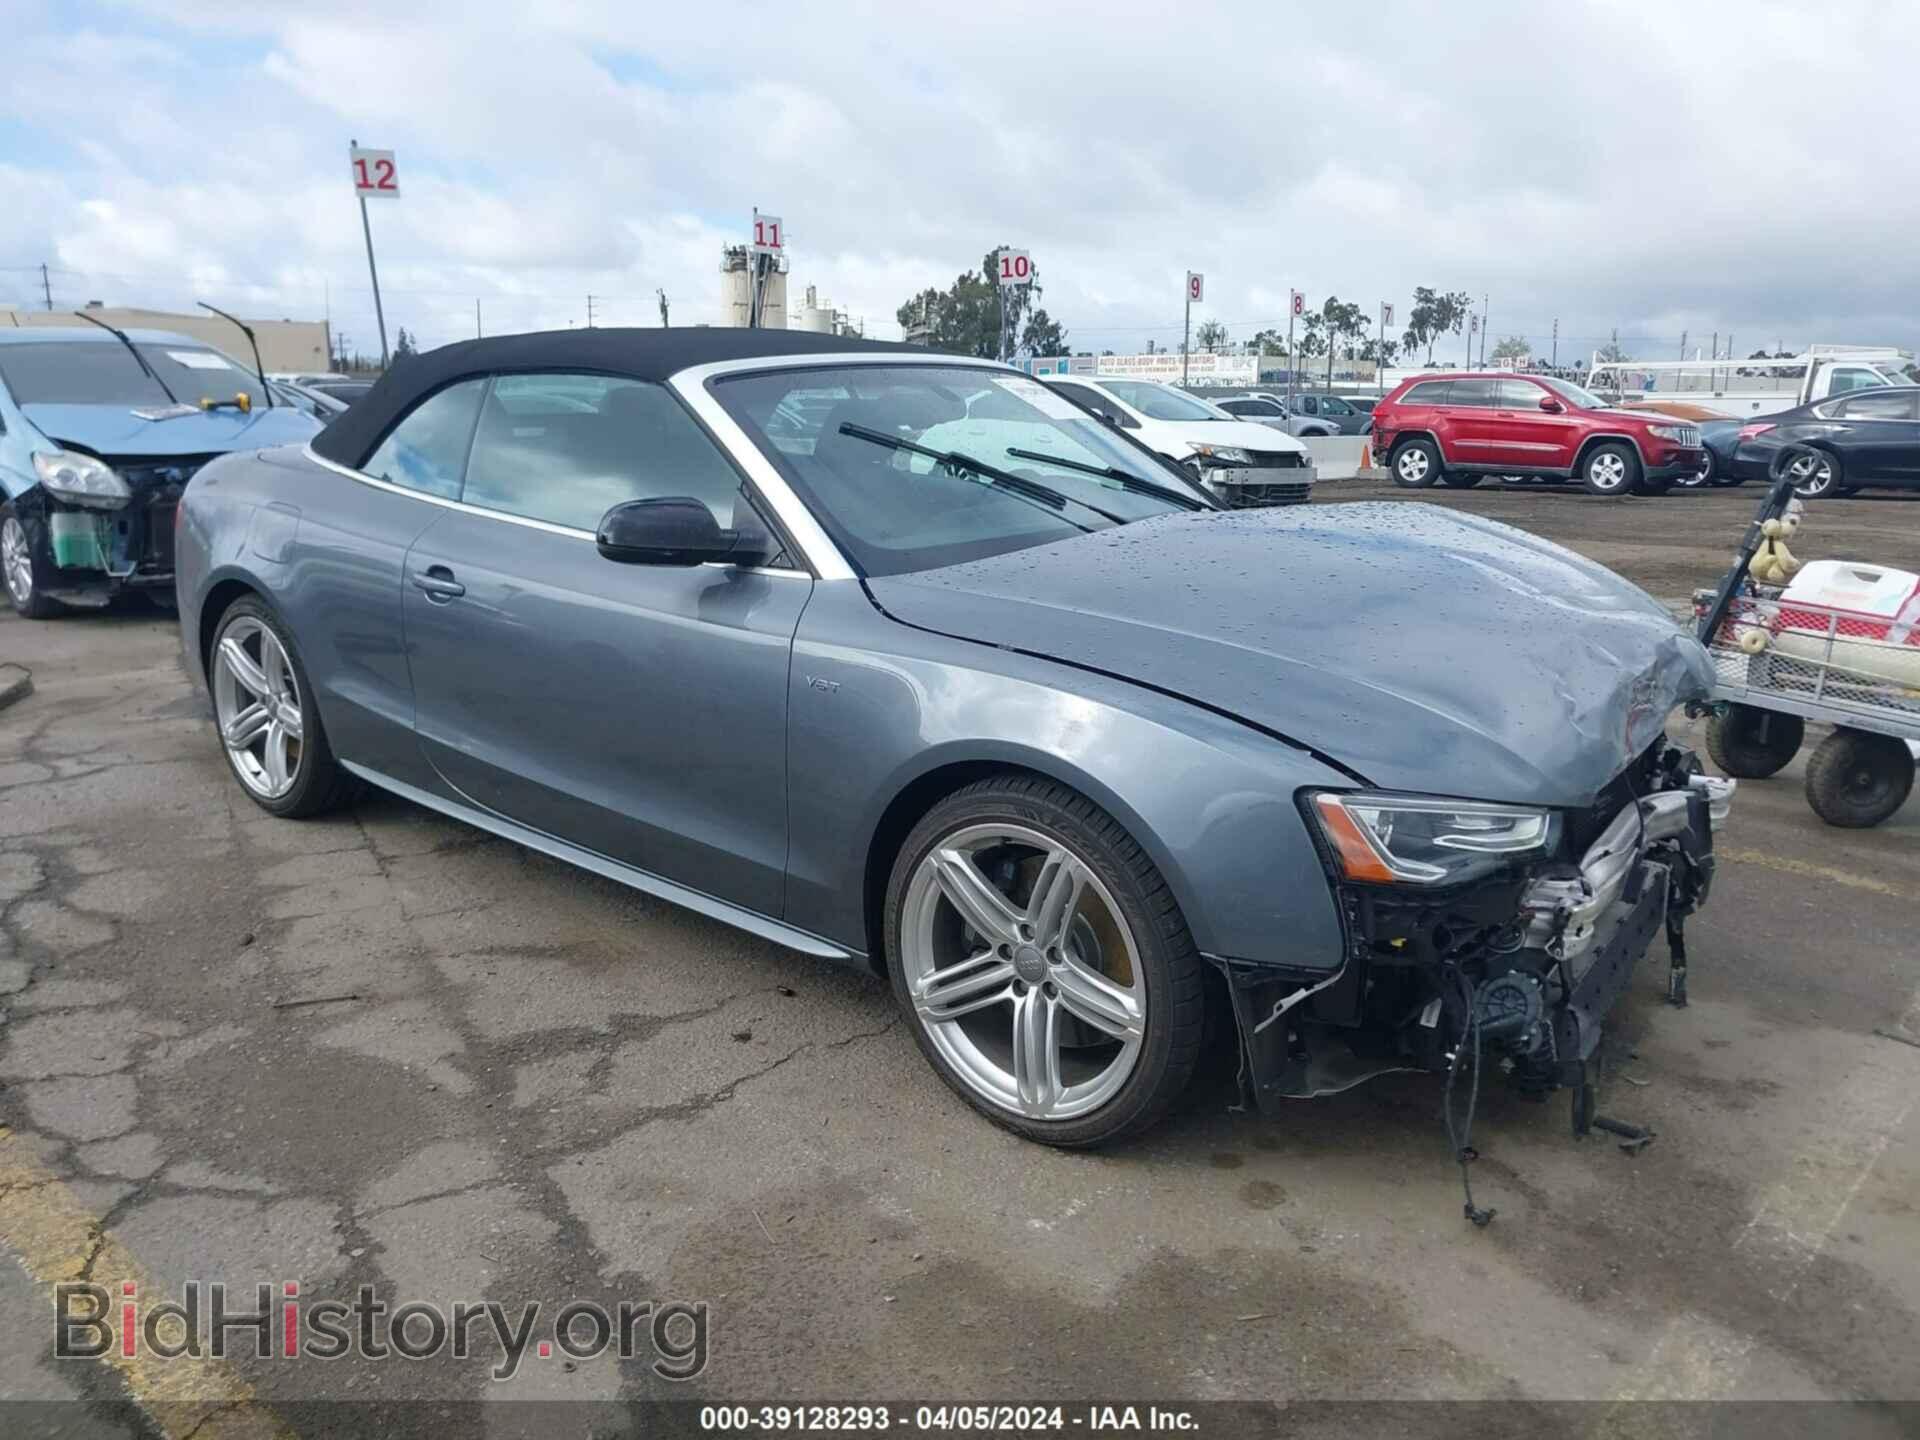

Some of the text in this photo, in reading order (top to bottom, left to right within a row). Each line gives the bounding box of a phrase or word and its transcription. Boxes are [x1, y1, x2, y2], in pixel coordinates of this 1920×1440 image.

[354, 158, 397, 190] 12
[755, 221, 781, 248] 11
[1001, 256, 1028, 278] 10
[1191, 276, 1200, 299] 9
[1294, 295, 1302, 315] 8
[1384, 306, 1392, 324] 7
[1100, 357, 1115, 366] AUTO
[1116, 357, 1136, 366] GLASS
[1137, 357, 1154, 366] BODY
[1156, 356, 1176, 365] PARTS
